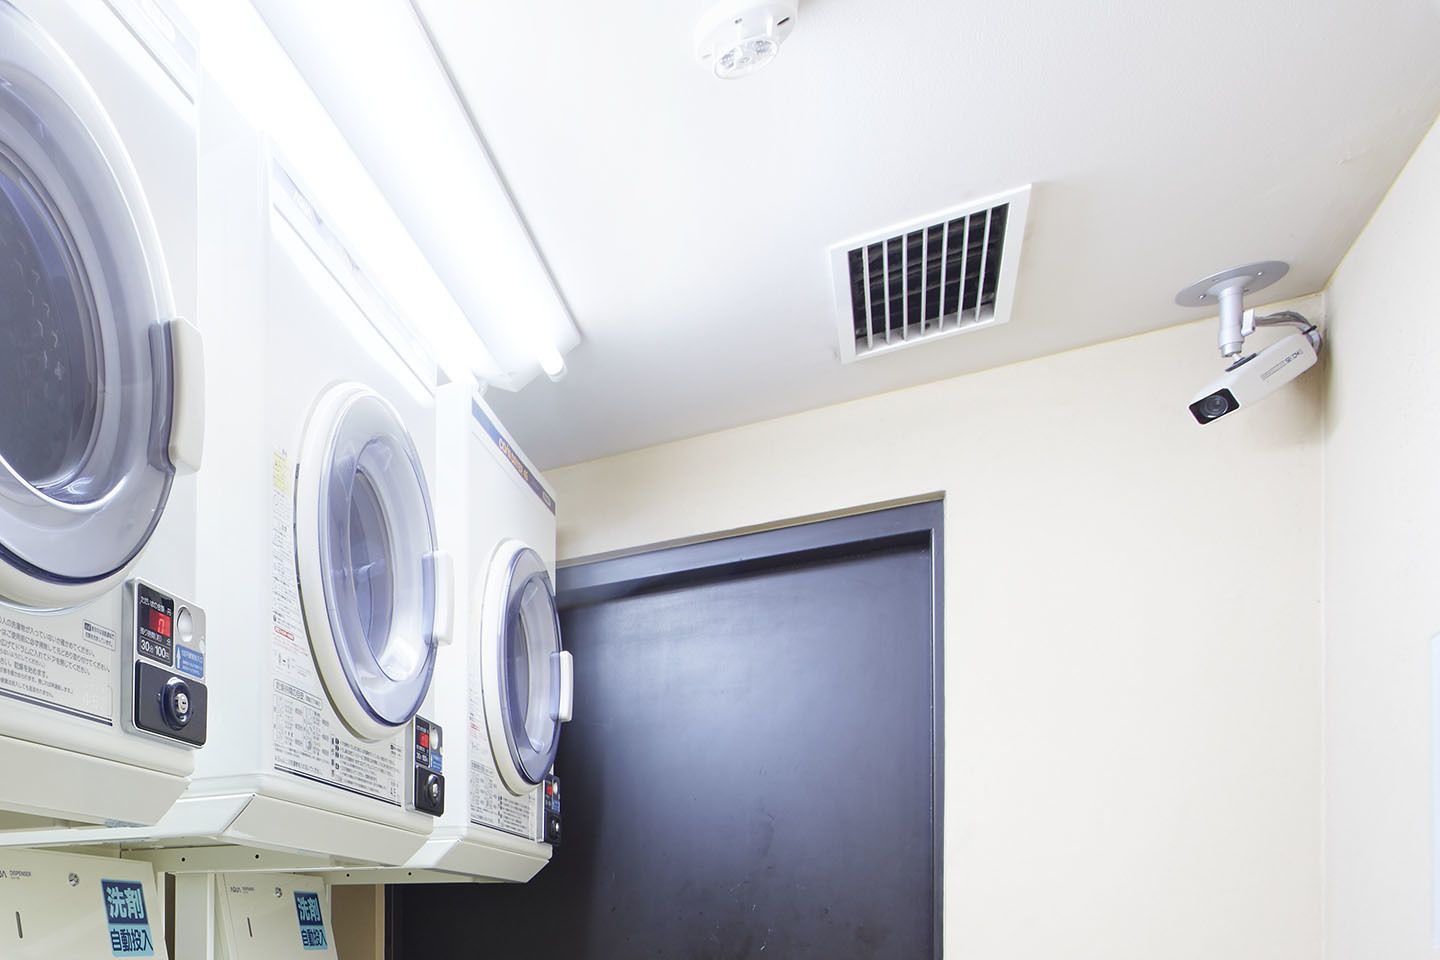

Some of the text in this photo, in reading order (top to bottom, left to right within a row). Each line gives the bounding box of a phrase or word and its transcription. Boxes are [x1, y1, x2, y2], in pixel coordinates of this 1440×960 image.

[107, 886, 144, 919] 洗剤
[297, 895, 320, 922] 洗剤
[110, 928, 154, 952] 自動投入
